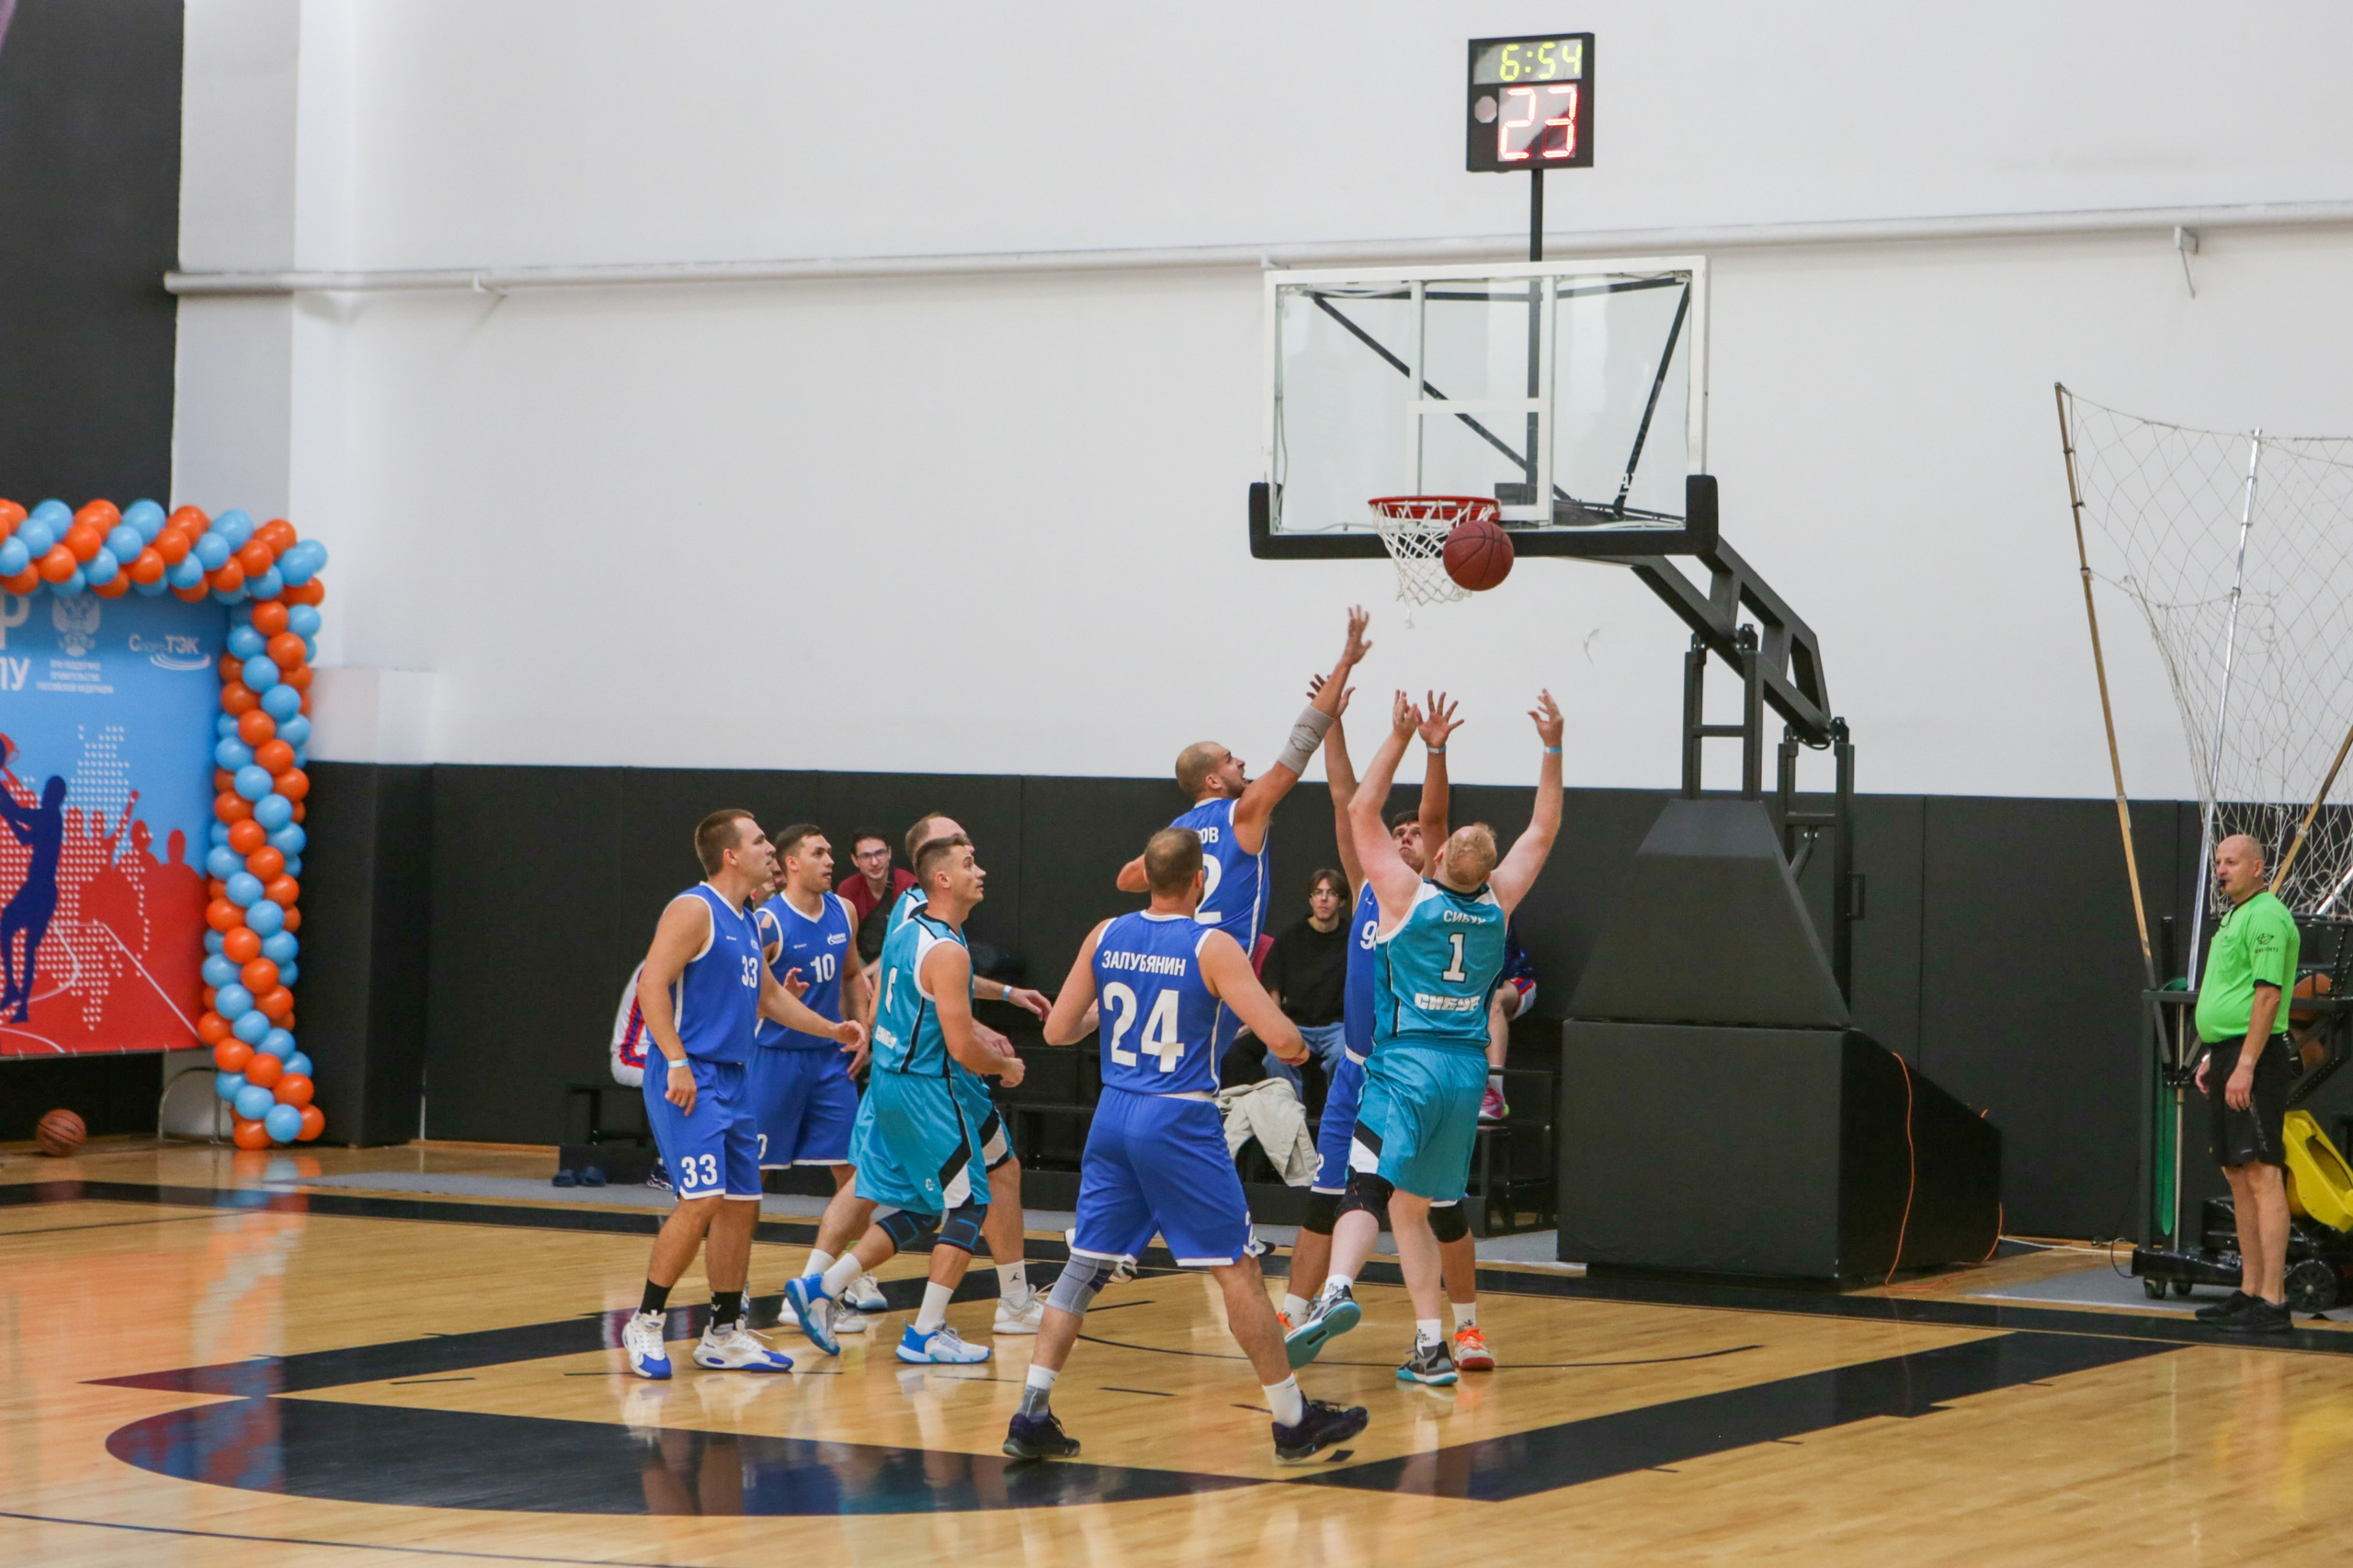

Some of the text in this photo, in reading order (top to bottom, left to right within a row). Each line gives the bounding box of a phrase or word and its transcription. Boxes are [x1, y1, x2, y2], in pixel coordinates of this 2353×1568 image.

[1499, 42, 1582, 82] 6:54
[1499, 85, 1579, 160] 23
[1196, 826, 1219, 844] ОВ
[1360, 920, 1378, 950] 9
[742, 955, 759, 989] 33
[810, 953, 835, 983] 10
[1101, 949, 1187, 977] ЗАЛУБЯНИН
[1441, 932, 1466, 983] 1
[1414, 993, 1481, 1012] СИБУР
[1103, 982, 1185, 1073] 24
[681, 1153, 718, 1188] 33
